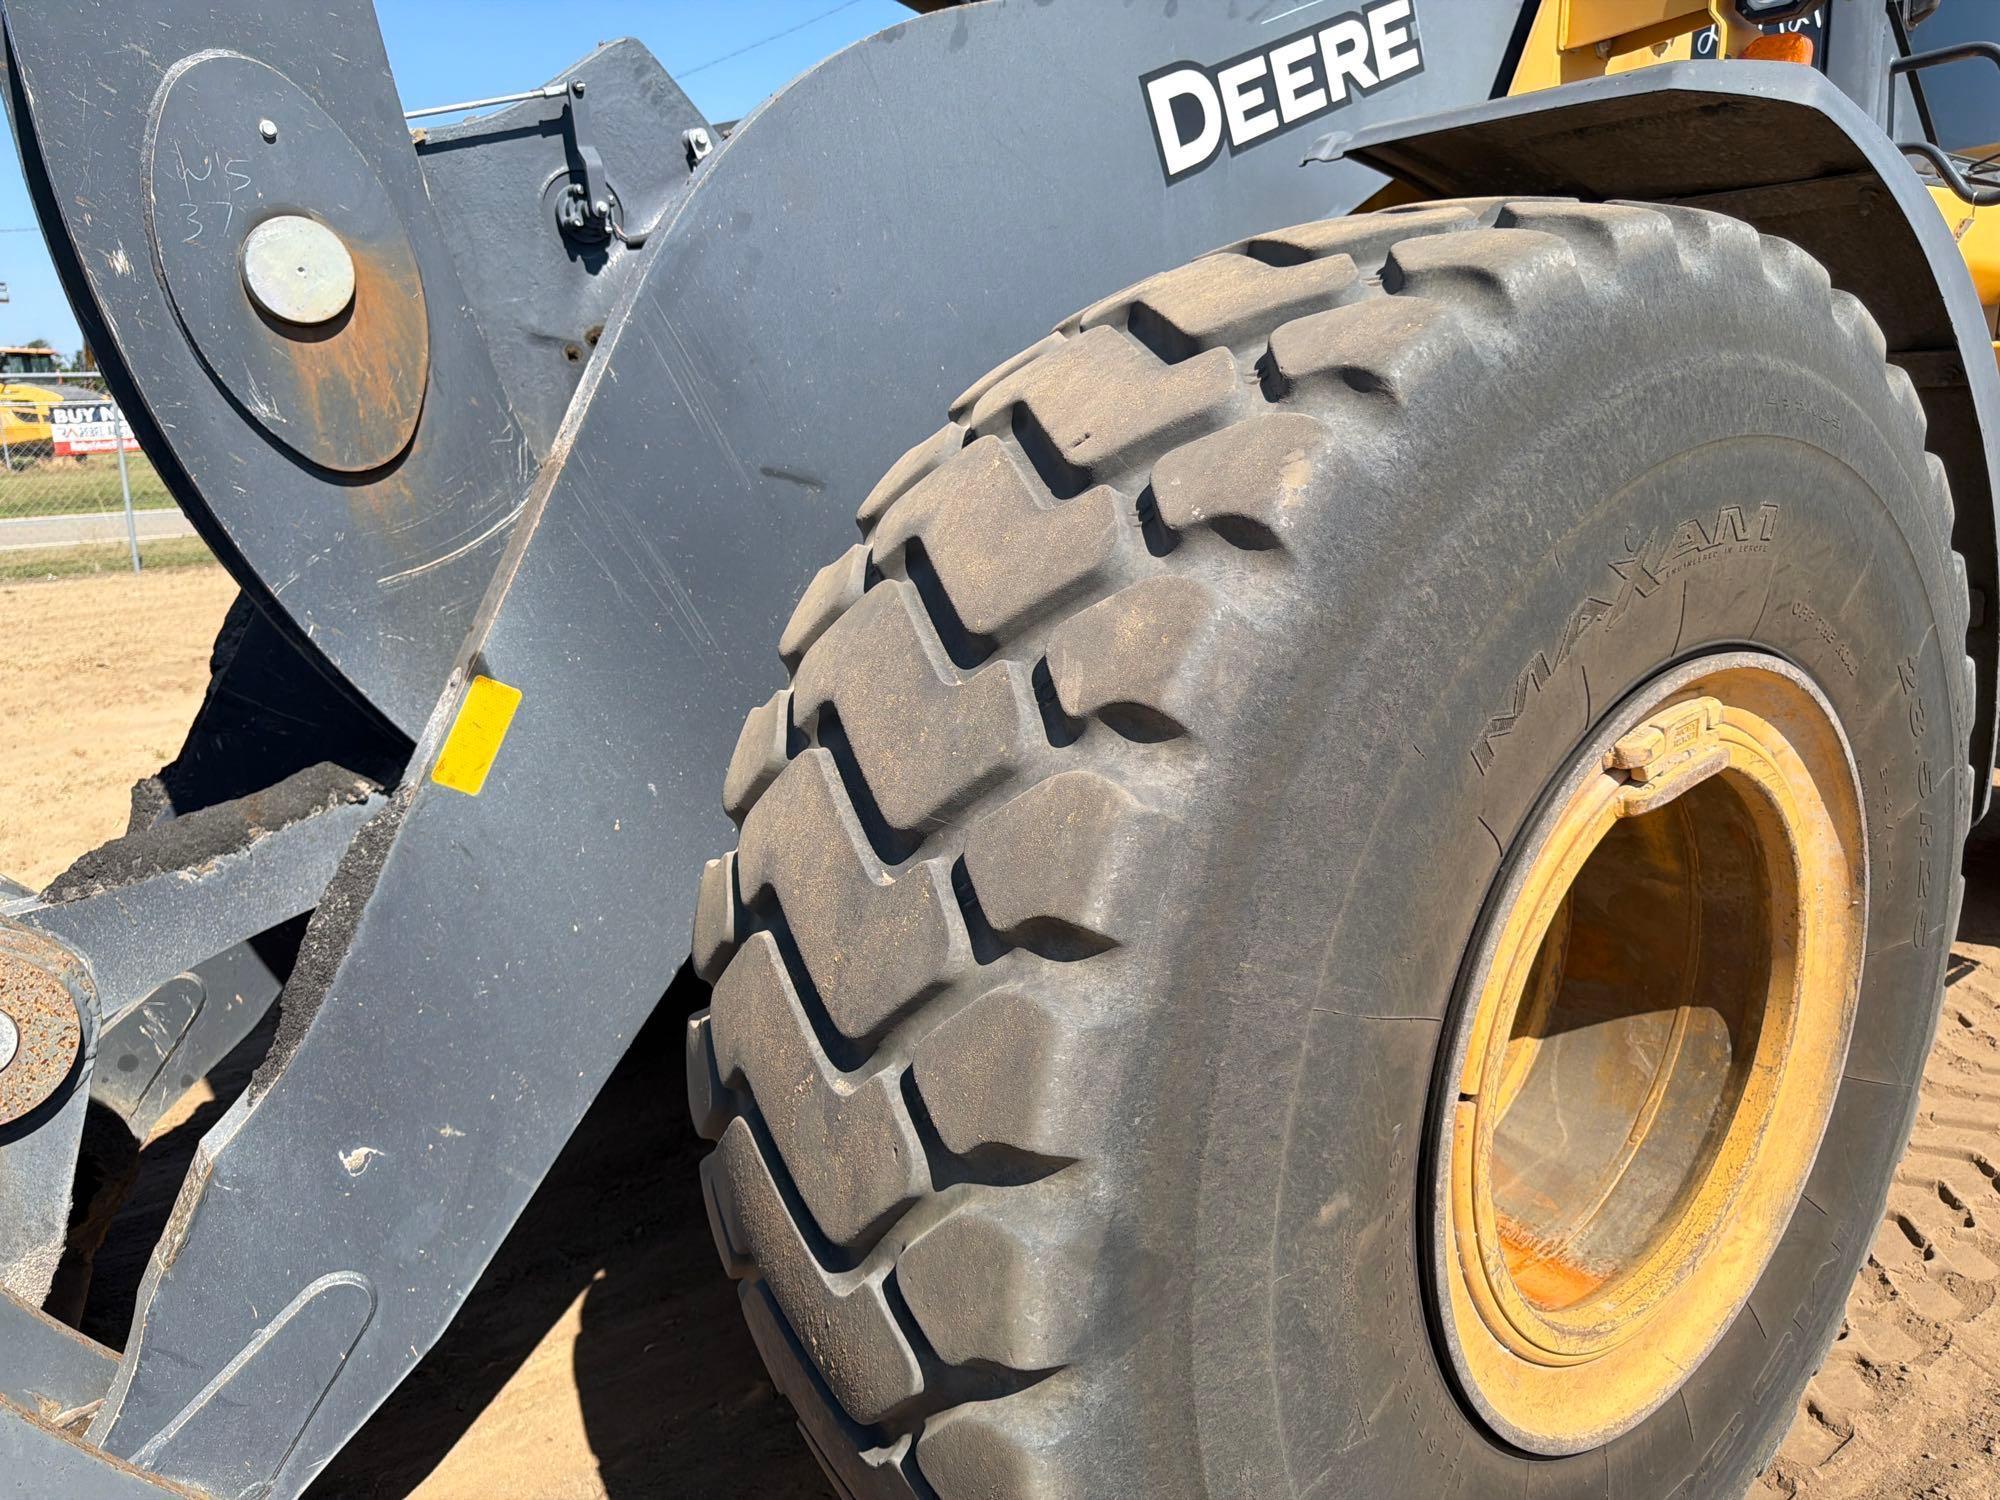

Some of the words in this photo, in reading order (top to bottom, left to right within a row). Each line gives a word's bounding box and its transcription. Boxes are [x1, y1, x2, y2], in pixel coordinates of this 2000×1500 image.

[1146, 0, 1420, 176] DEERE
[53, 408, 95, 424] BUY
[1470, 502, 1780, 777] MAXAM
[1791, 599, 1814, 625] OFF
[1814, 616, 1836, 646] THE
